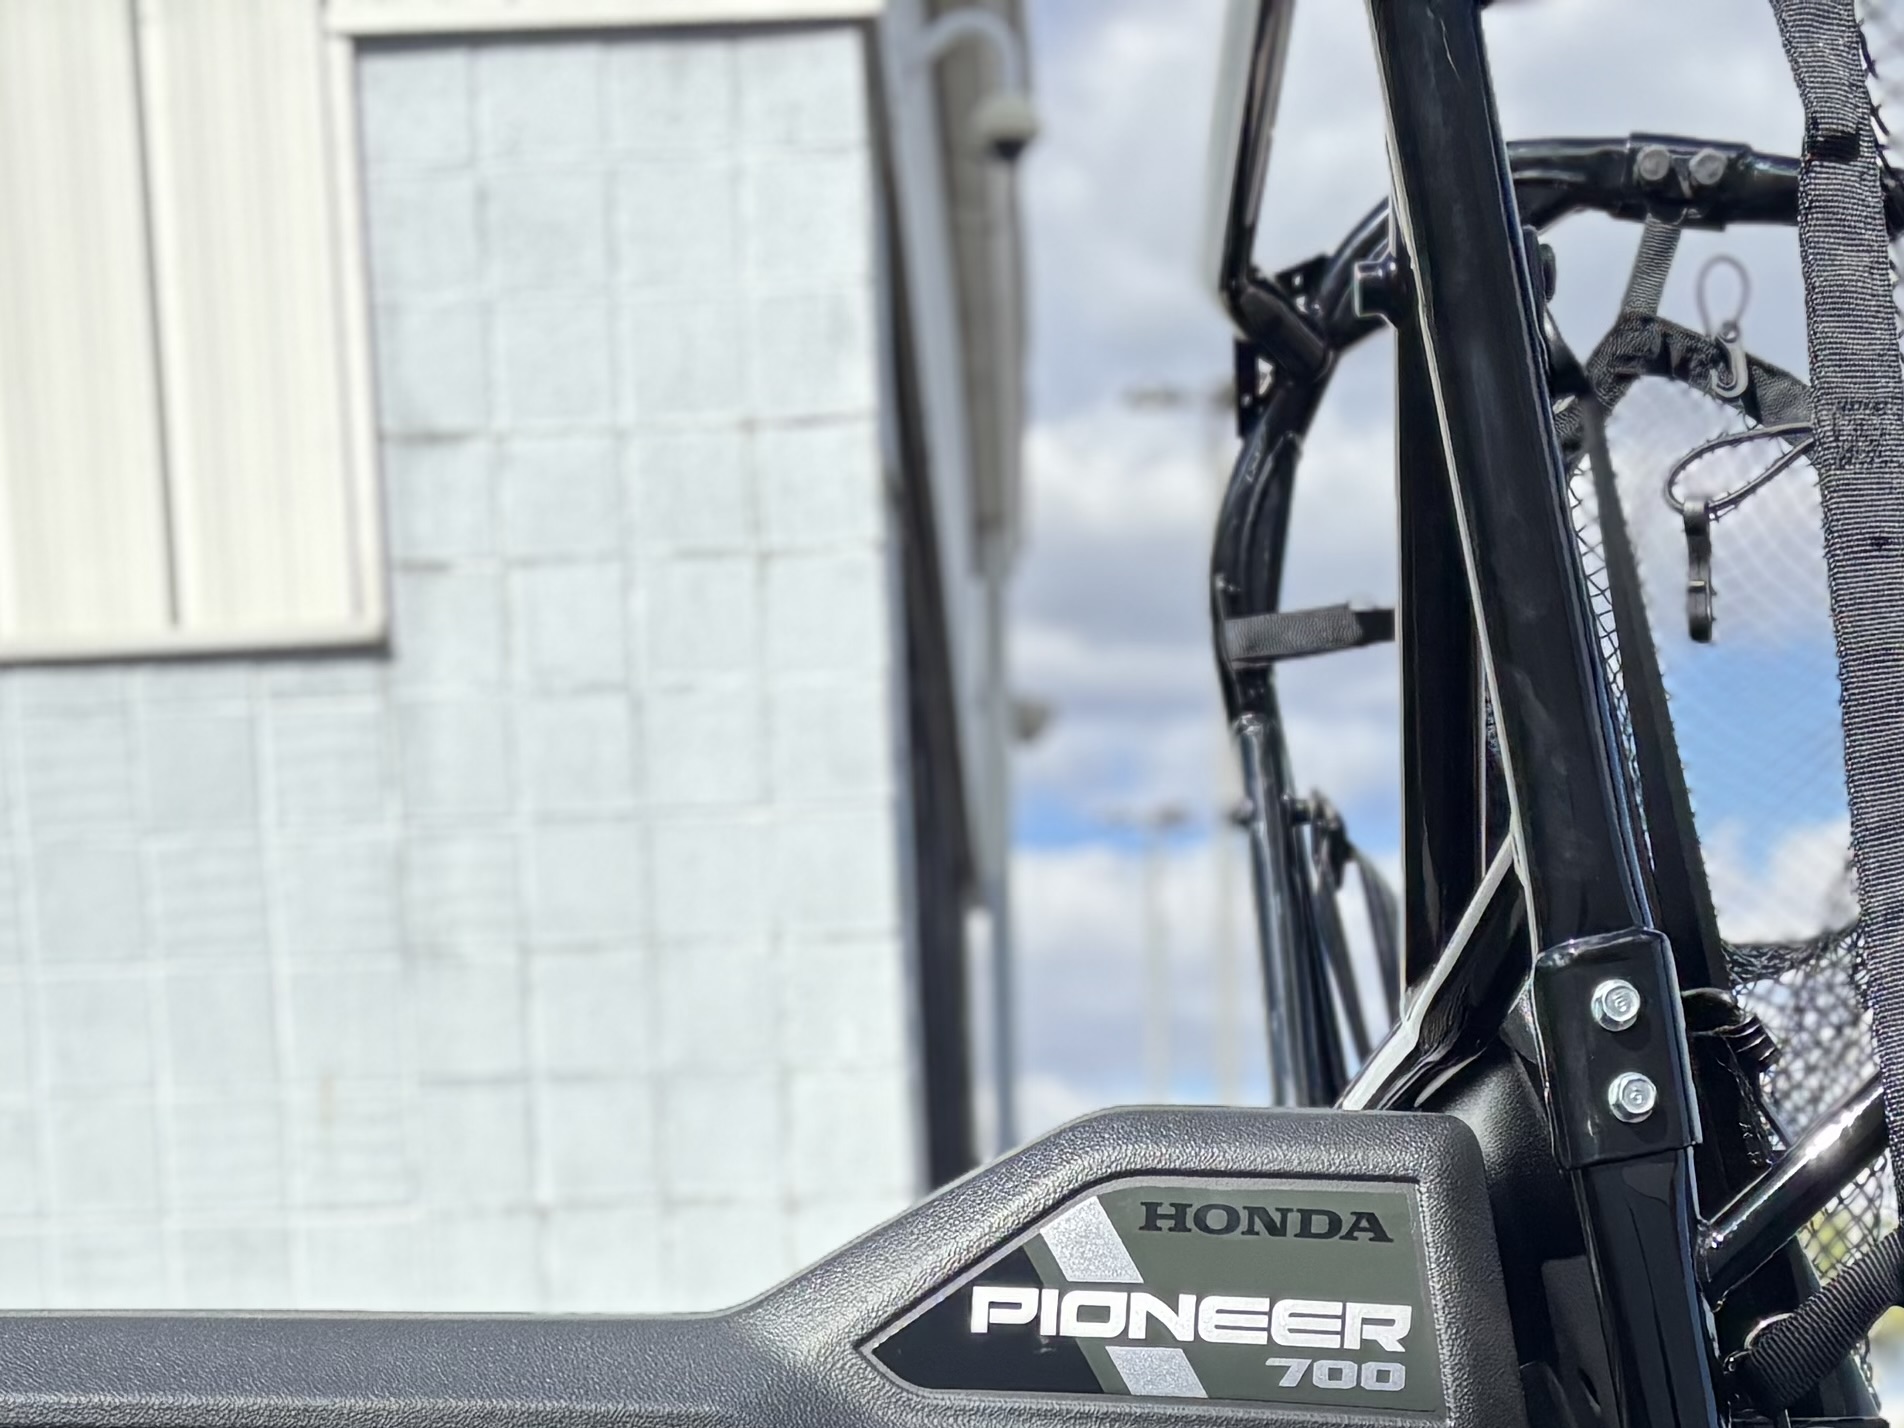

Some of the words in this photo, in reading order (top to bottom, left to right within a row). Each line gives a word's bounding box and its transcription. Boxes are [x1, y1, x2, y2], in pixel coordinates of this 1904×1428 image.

[1139, 1201, 1394, 1243] HONDA
[970, 1285, 1413, 1353] PIONEER
[1265, 1358, 1407, 1392] 700
